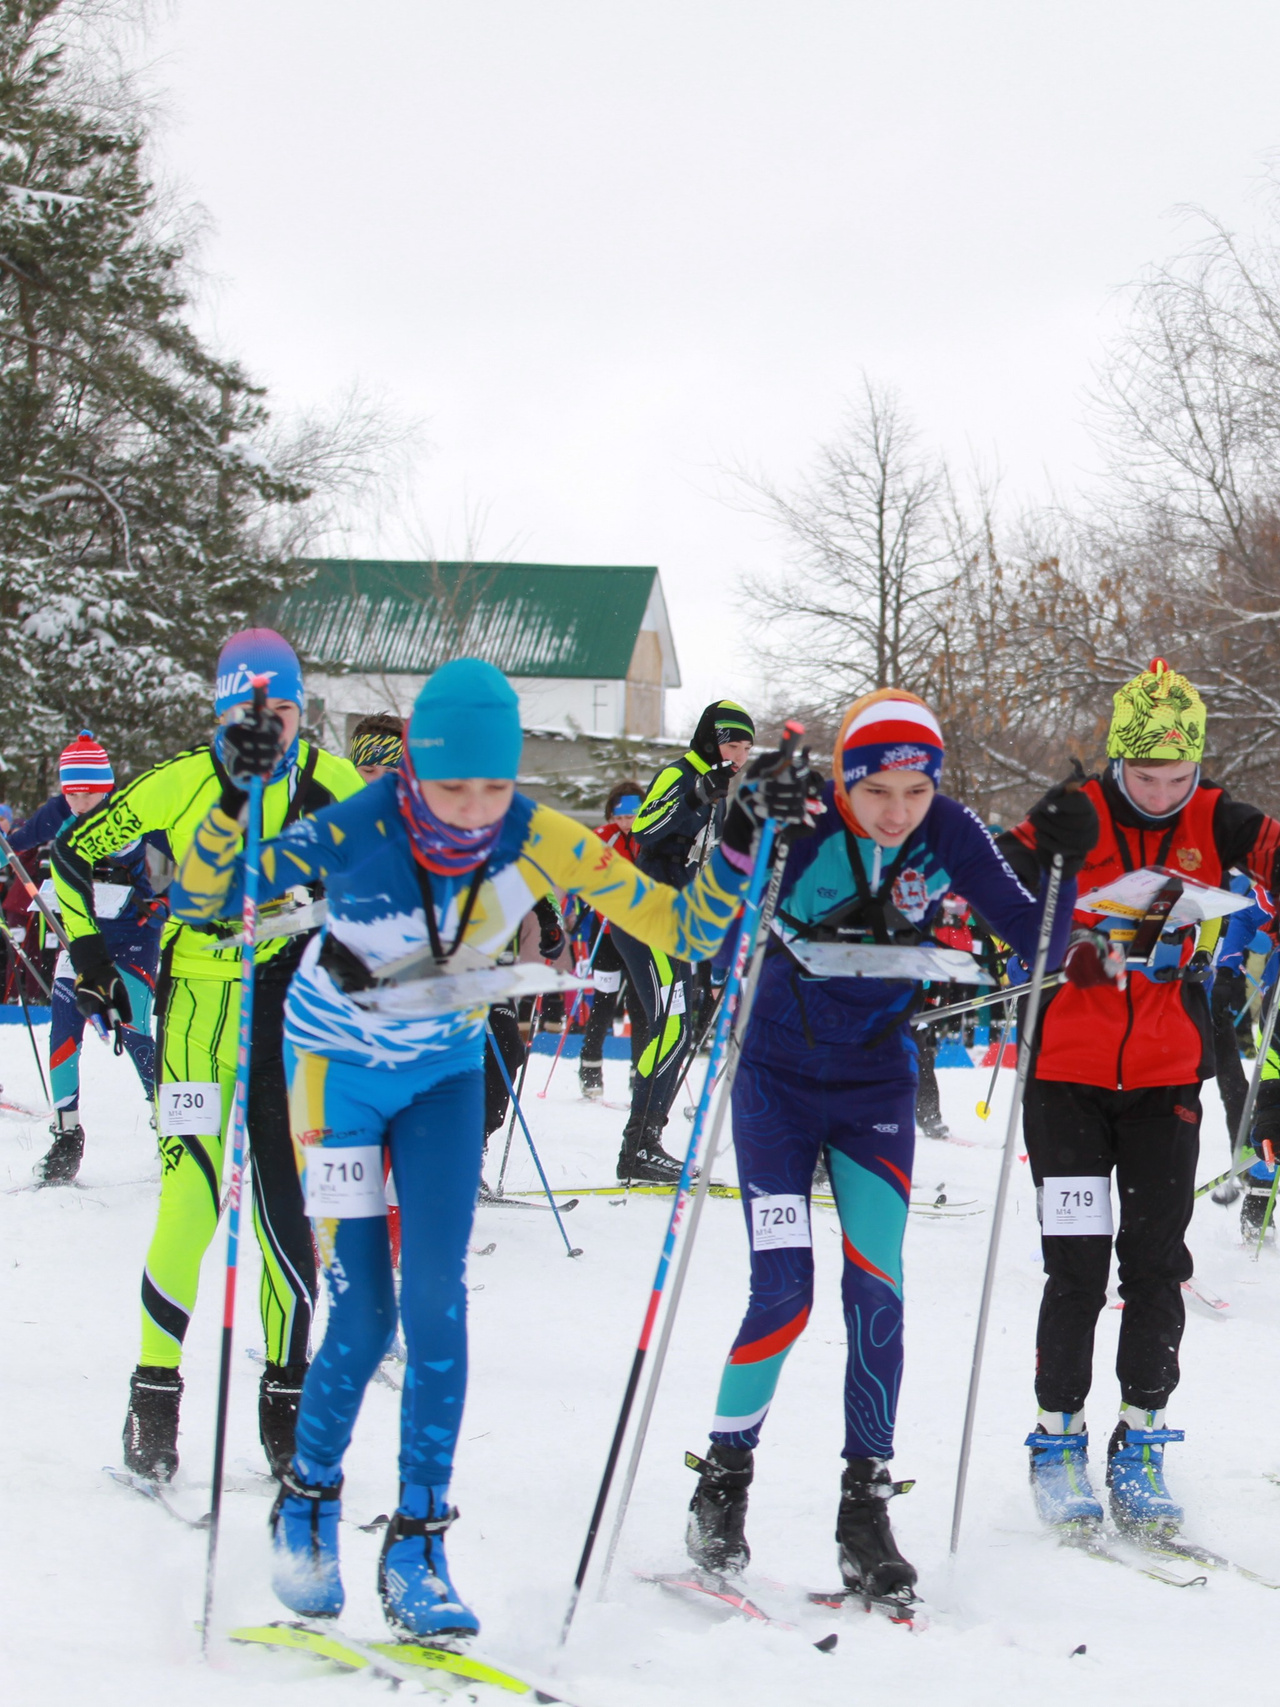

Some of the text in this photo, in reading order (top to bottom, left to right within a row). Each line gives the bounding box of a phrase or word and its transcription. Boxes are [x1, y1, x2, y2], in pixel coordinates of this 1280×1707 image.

[172, 1093, 204, 1109] 730
[323, 1162, 364, 1182] 710
[1060, 1190, 1094, 1208] 719
[759, 1206, 797, 1227] 720
